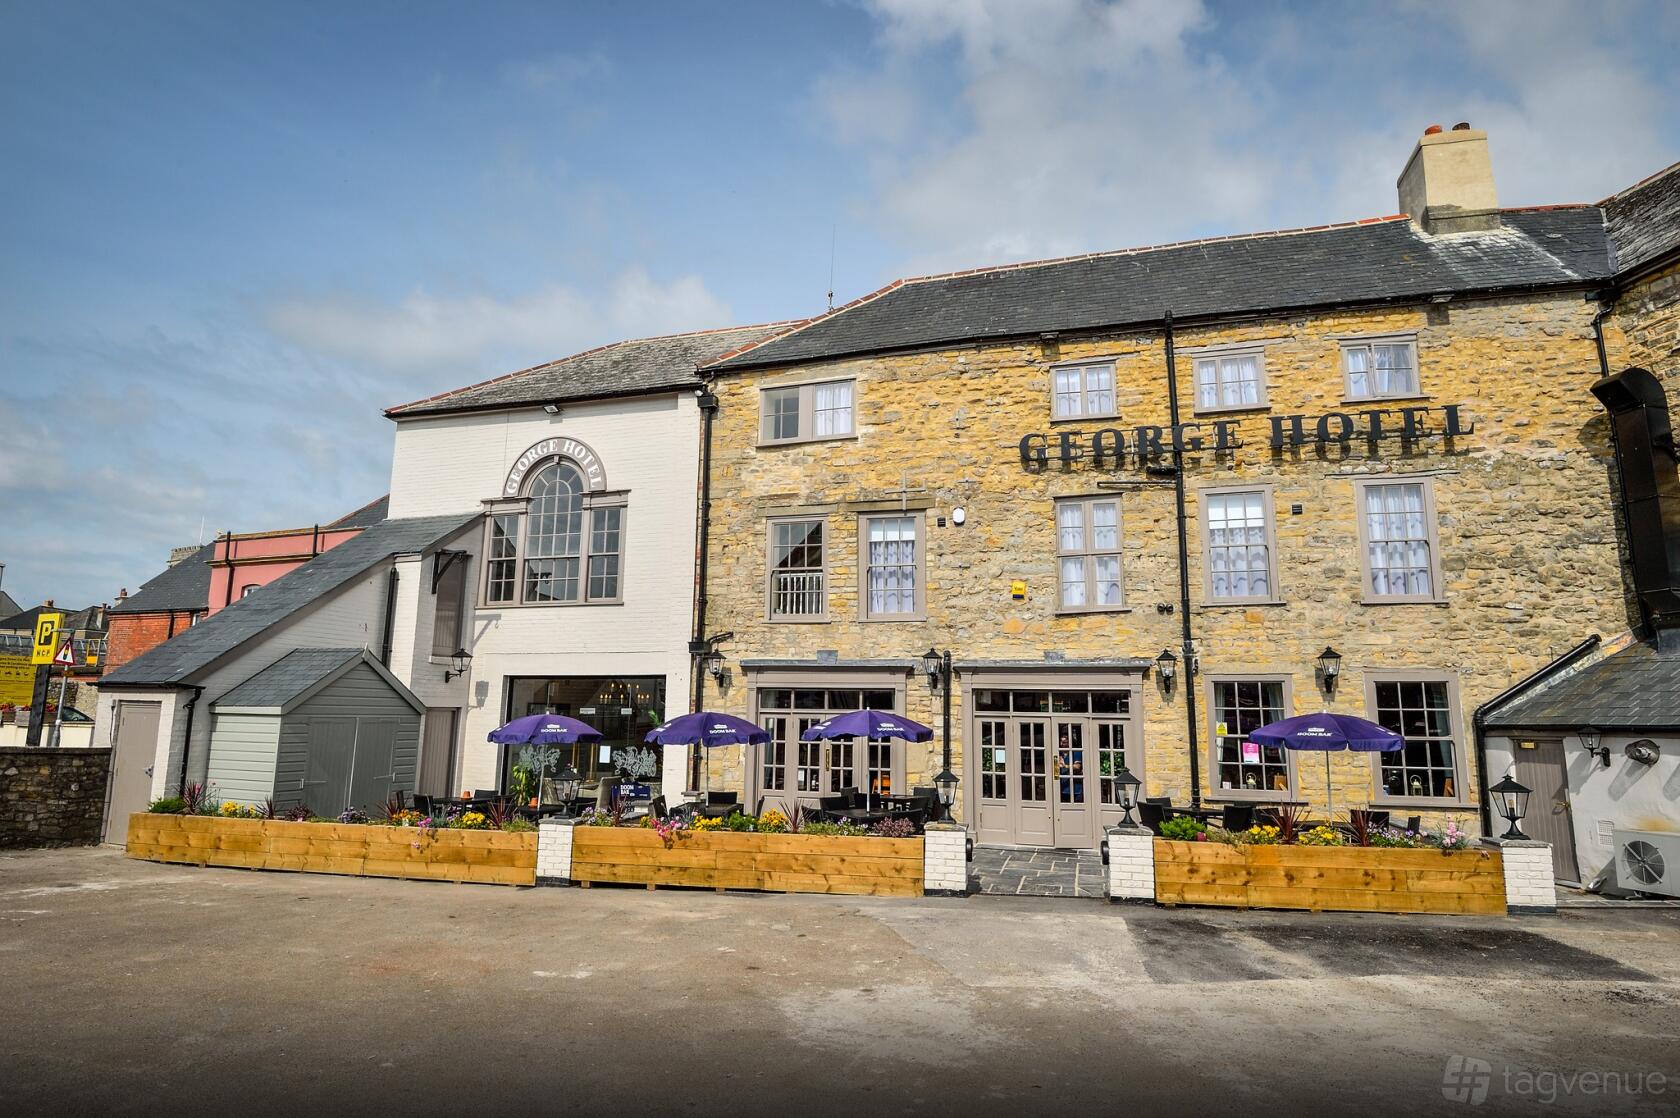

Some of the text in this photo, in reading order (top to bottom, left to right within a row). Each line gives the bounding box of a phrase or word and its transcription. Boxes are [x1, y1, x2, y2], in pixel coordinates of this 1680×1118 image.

[1019, 404, 1475, 462] GEORGE HOTEL
[506, 439, 602, 494] GEORGE HOTEL
[40, 623, 52, 643] P
